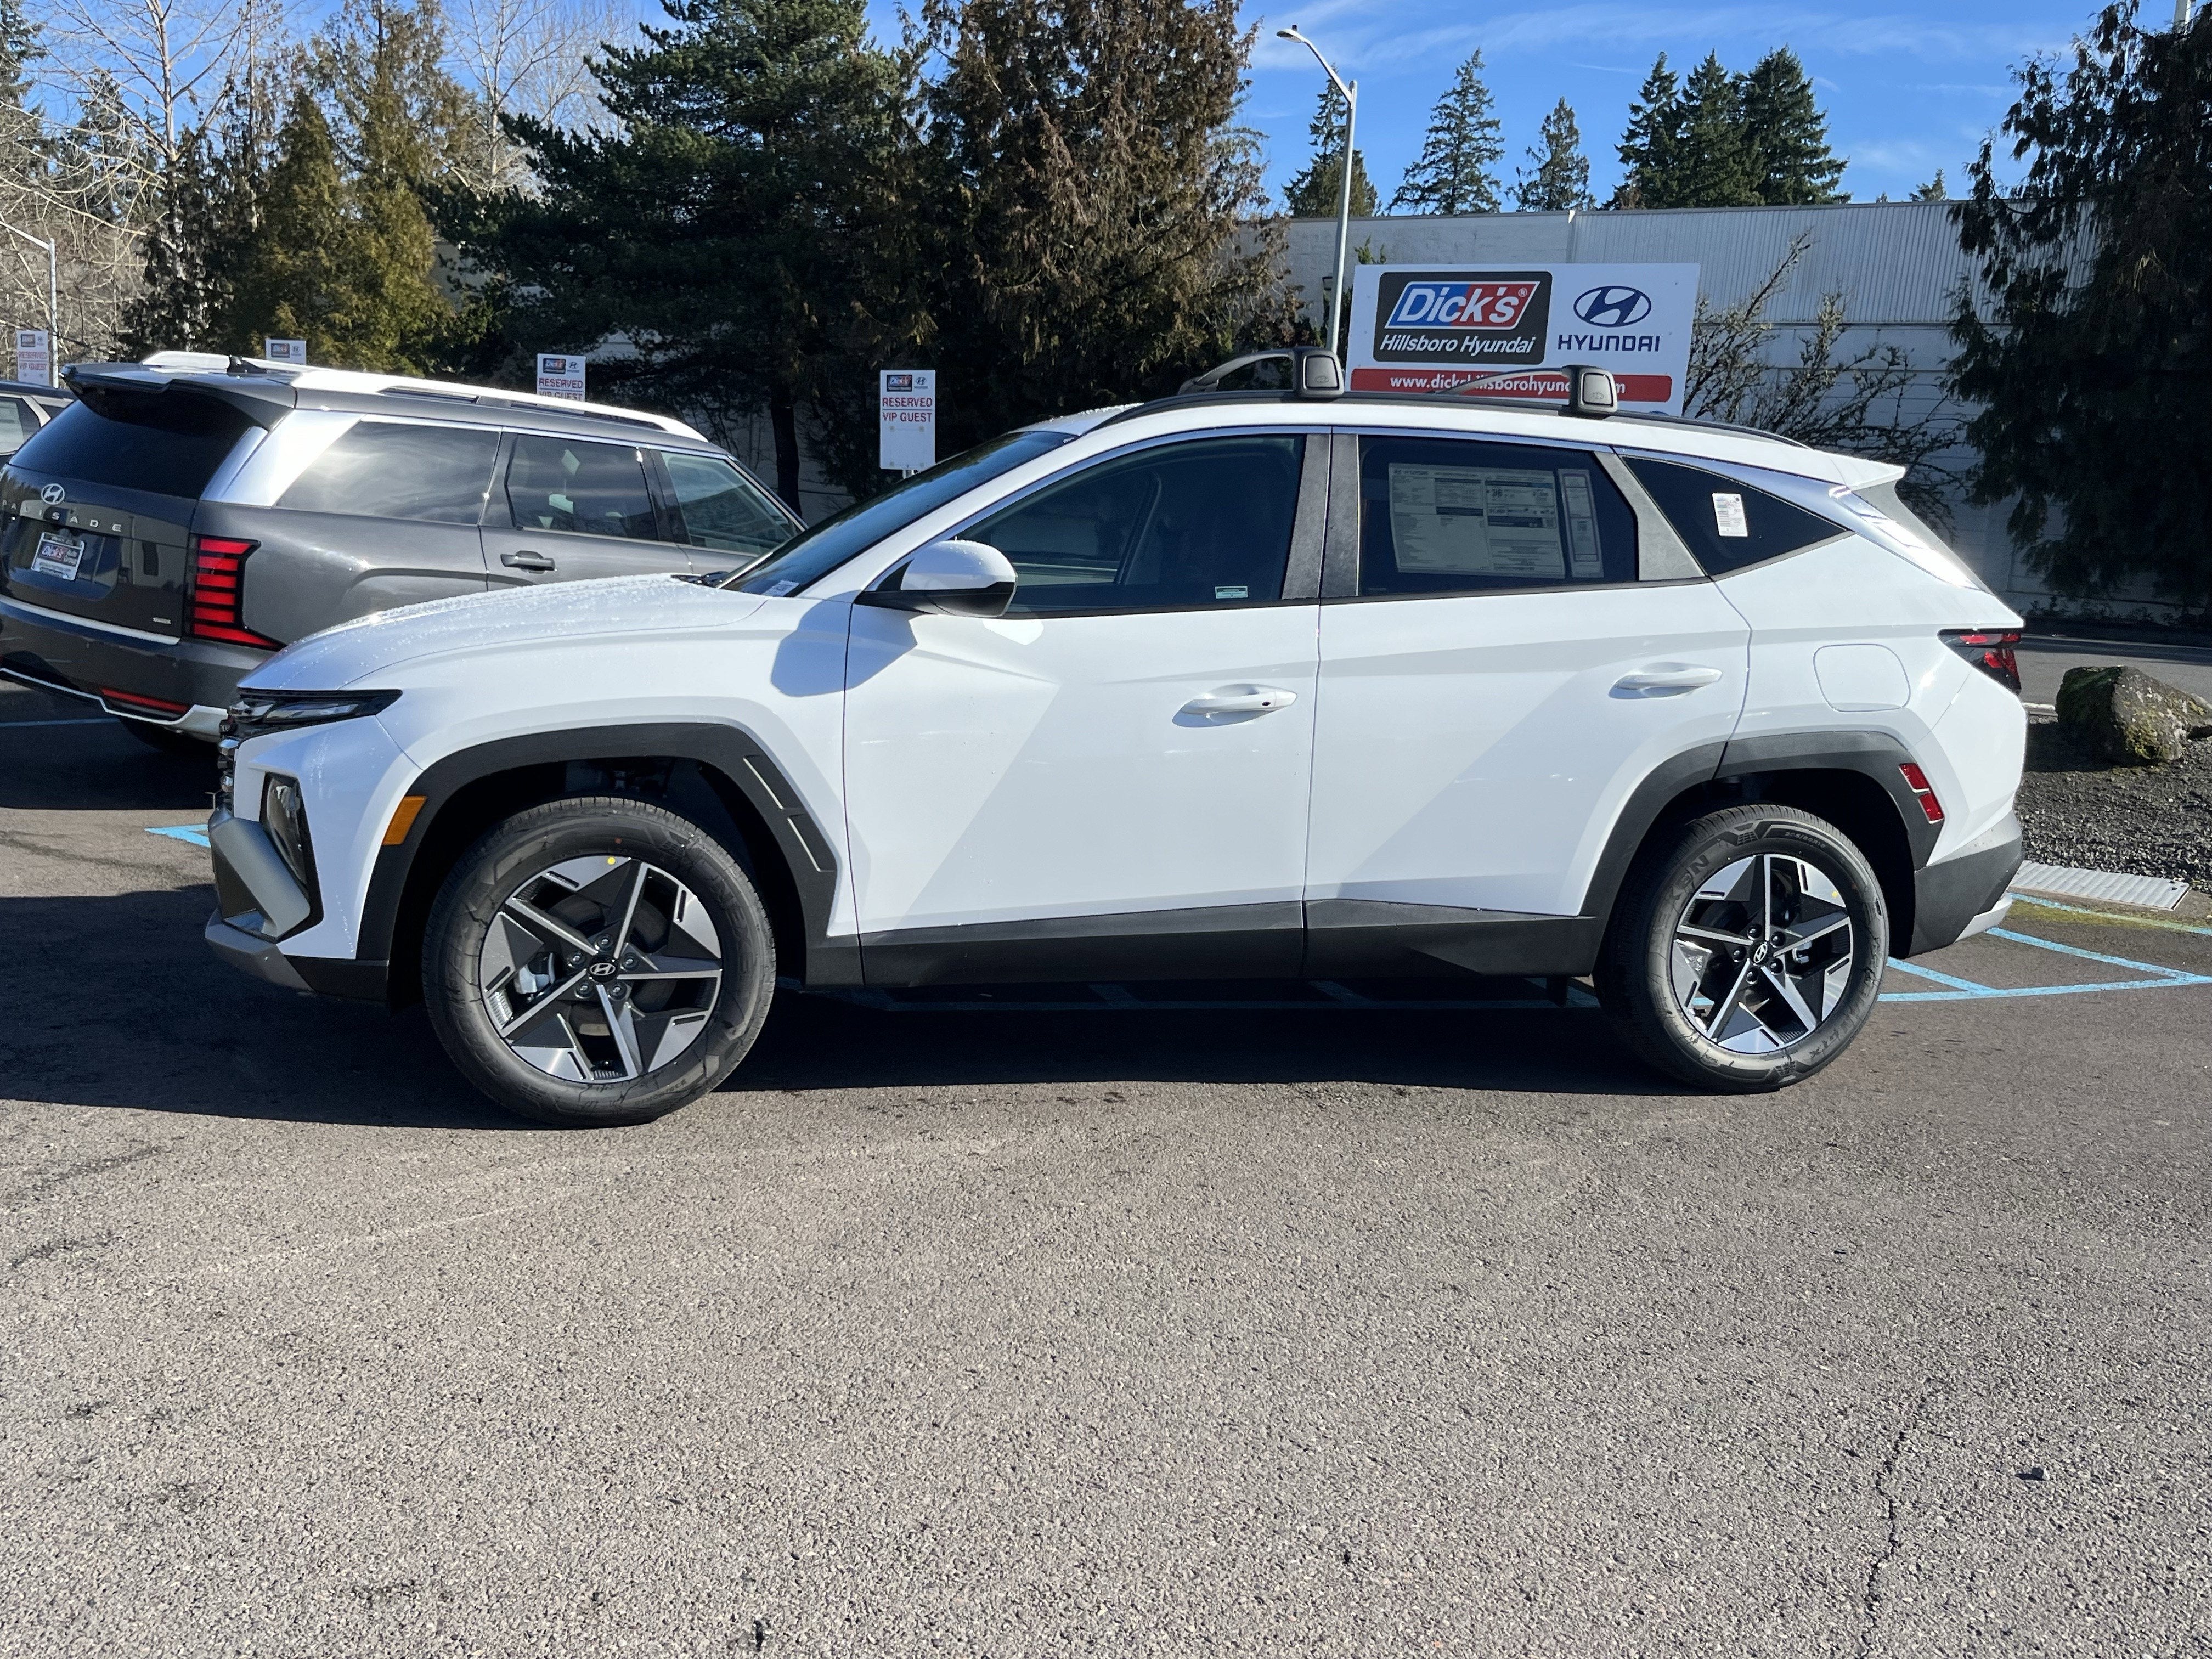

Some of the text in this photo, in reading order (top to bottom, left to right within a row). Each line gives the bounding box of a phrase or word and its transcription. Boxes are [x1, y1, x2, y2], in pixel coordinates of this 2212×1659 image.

[1397, 287, 1519, 323] Dick's
[1380, 334, 1537, 357] Hillsboro Hyundai
[1558, 334, 1661, 352] HYUNDAI
[539, 377, 583, 389] RESERVED
[882, 397, 933, 408] RESERVED
[882, 412, 932, 422] VIP GUEST
[2, 499, 122, 532] PALISADE
